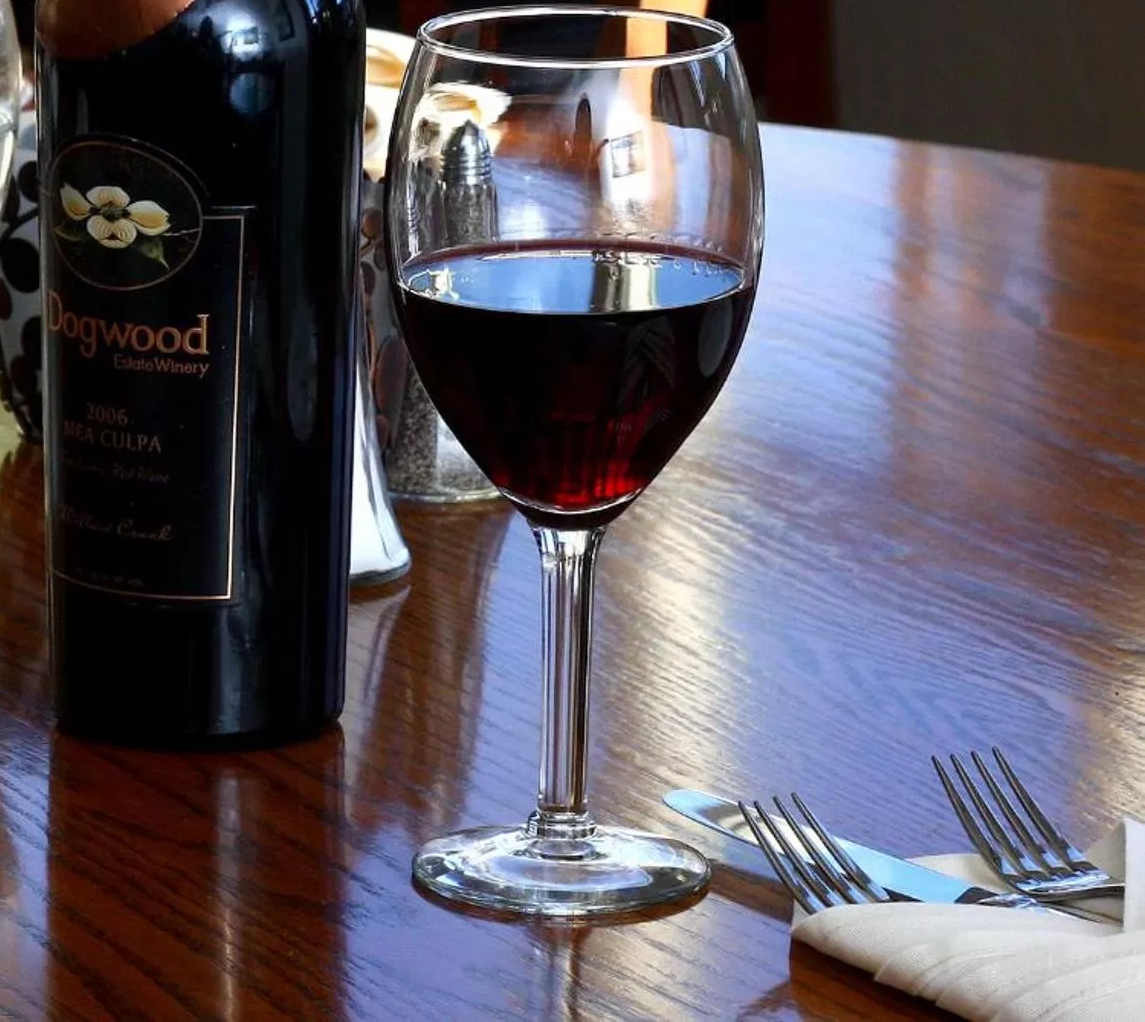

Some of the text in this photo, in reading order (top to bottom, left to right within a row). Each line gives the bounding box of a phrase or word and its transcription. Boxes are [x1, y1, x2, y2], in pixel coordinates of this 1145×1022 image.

[48, 289, 210, 358] Dogwood
[86, 401, 129, 426] 2006
[101, 428, 162, 454] CULPA
